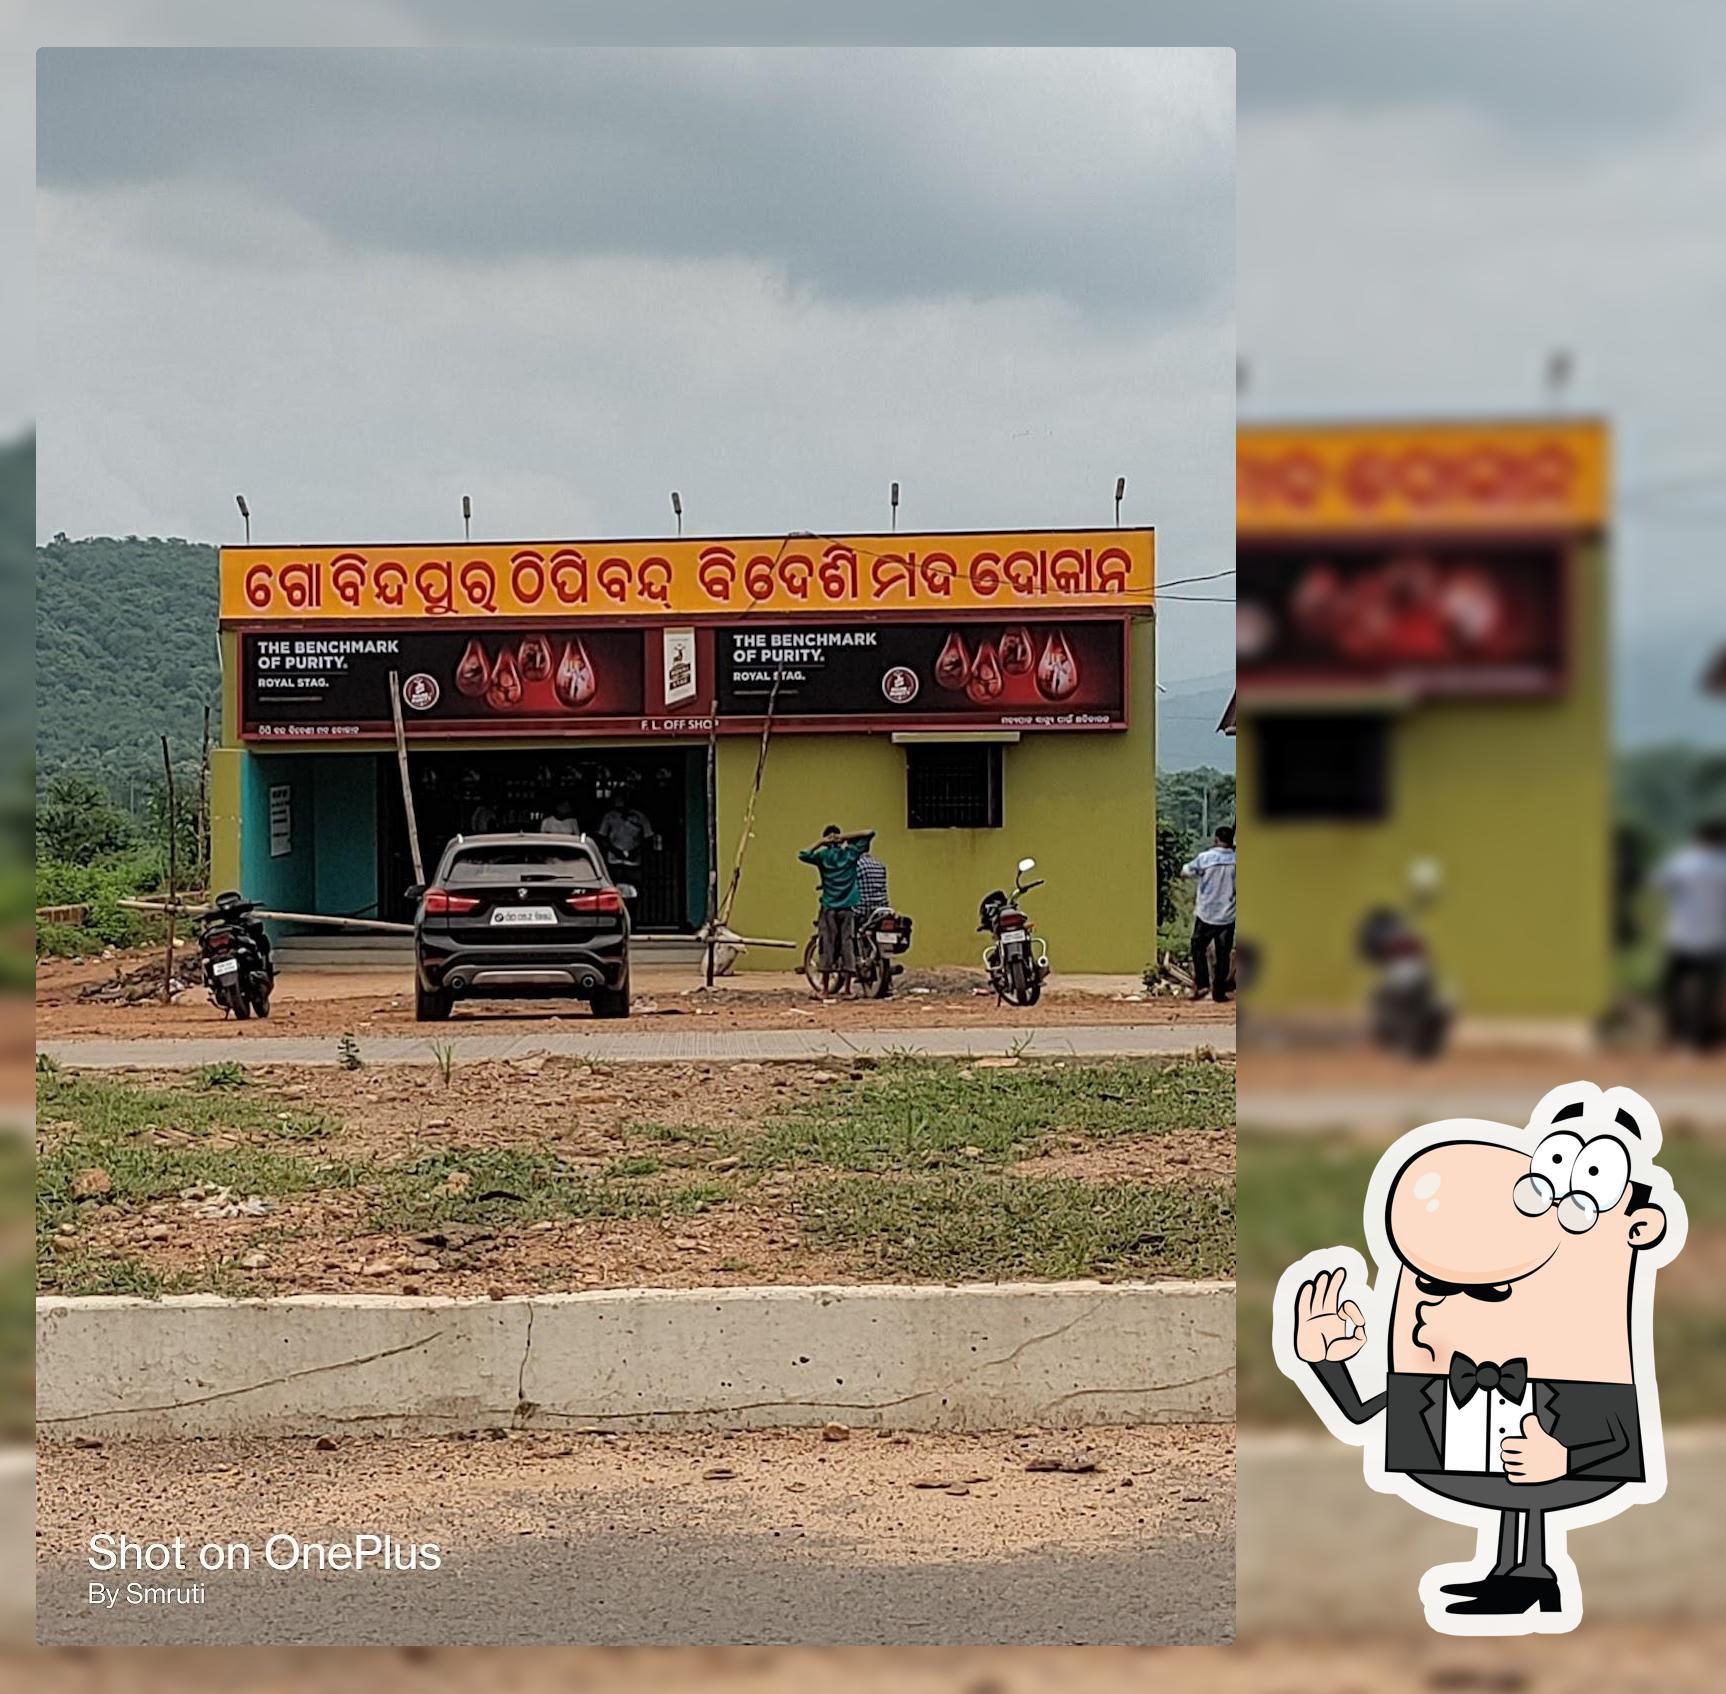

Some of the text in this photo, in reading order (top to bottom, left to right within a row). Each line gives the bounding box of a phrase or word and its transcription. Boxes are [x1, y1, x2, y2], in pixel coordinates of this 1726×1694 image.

[257, 640, 400, 654] THE BENCHMARK
[732, 632, 878, 648] THE BENCHMARK
[732, 648, 826, 663] OF PURITY.
[257, 656, 349, 670] OF PURITY.
[257, 677, 330, 688] ROYAL STAG.
[732, 671, 771, 682] ROYAL
[663, 720, 687, 731] OFF
